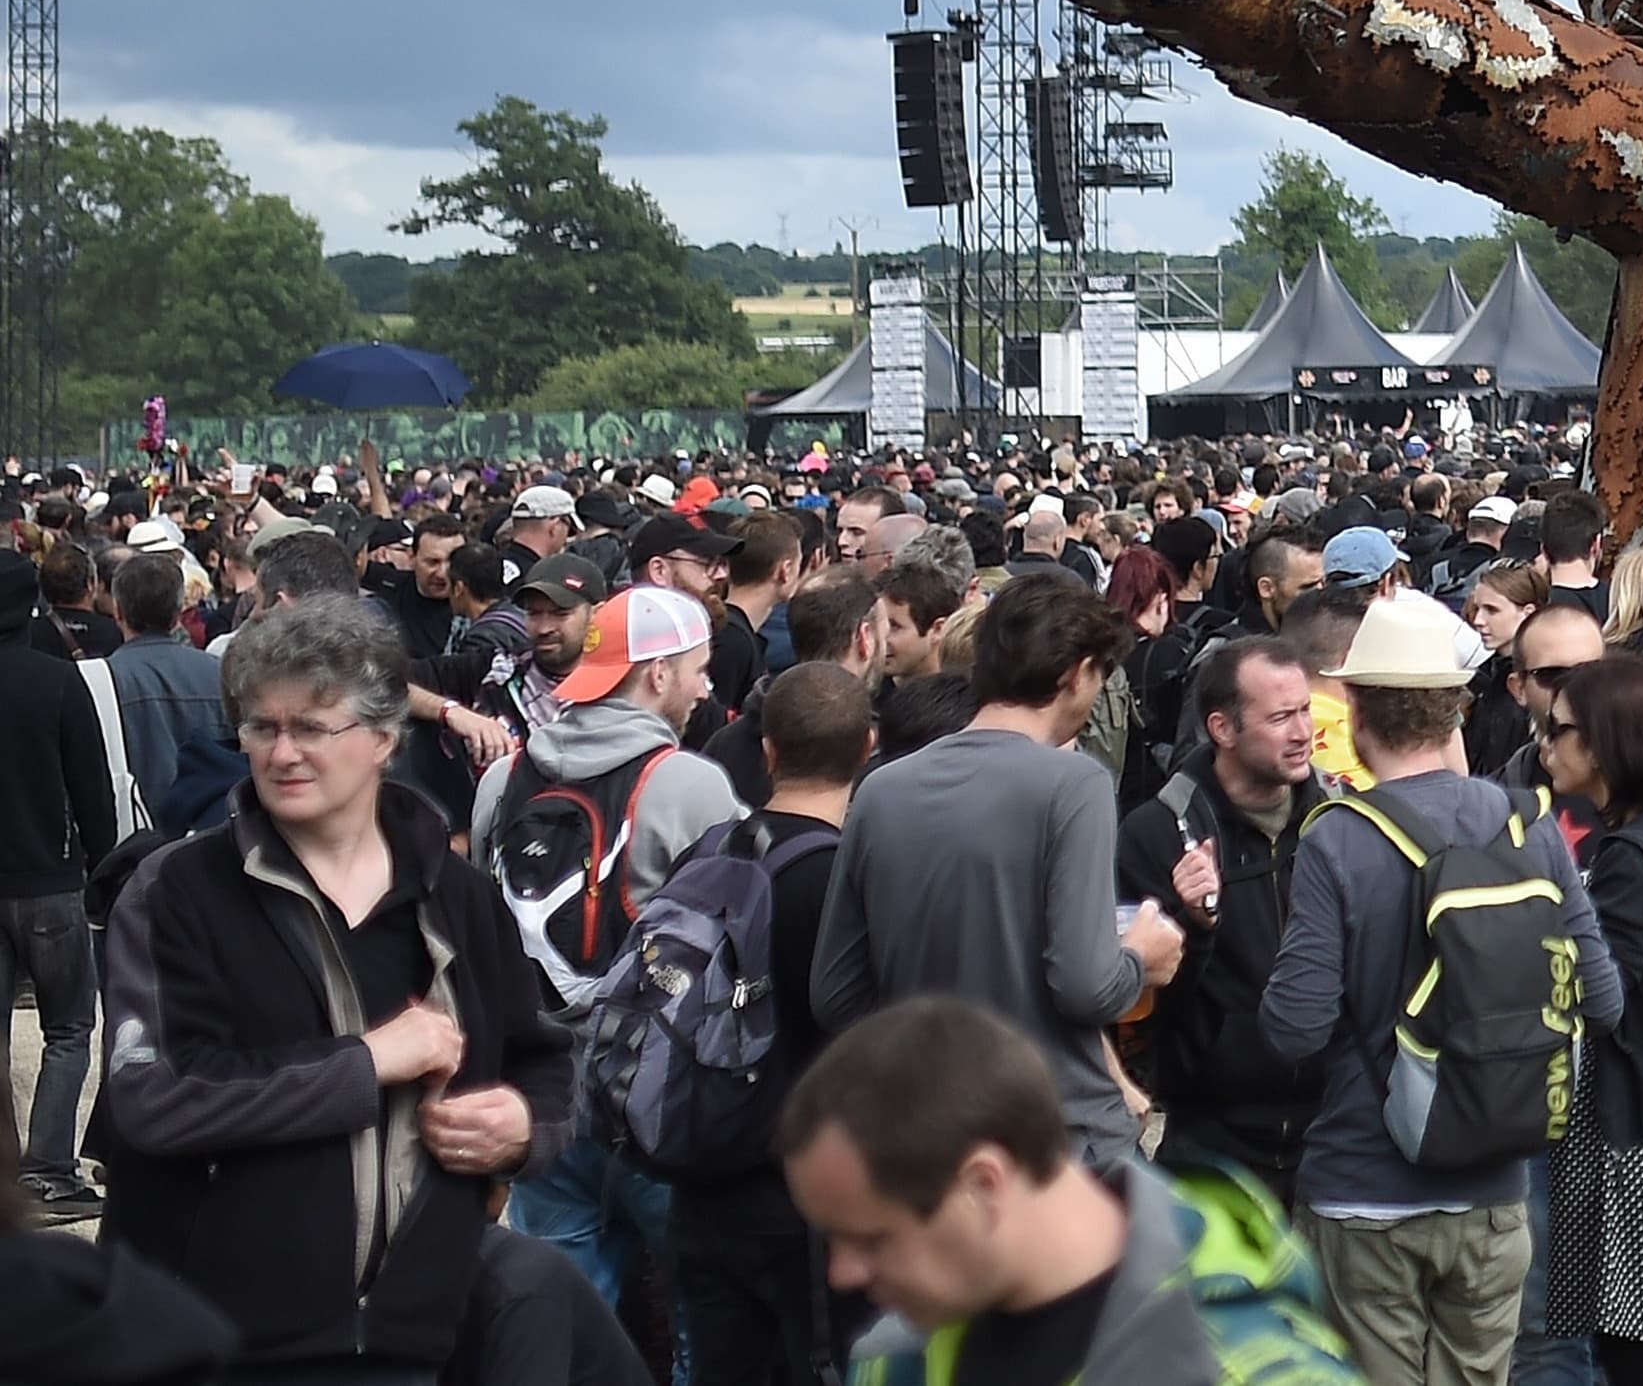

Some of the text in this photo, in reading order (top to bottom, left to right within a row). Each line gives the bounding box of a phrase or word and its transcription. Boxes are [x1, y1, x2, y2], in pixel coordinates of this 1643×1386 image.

[1381, 366, 1409, 389] BAR
[1541, 935, 1577, 1139] new feel
